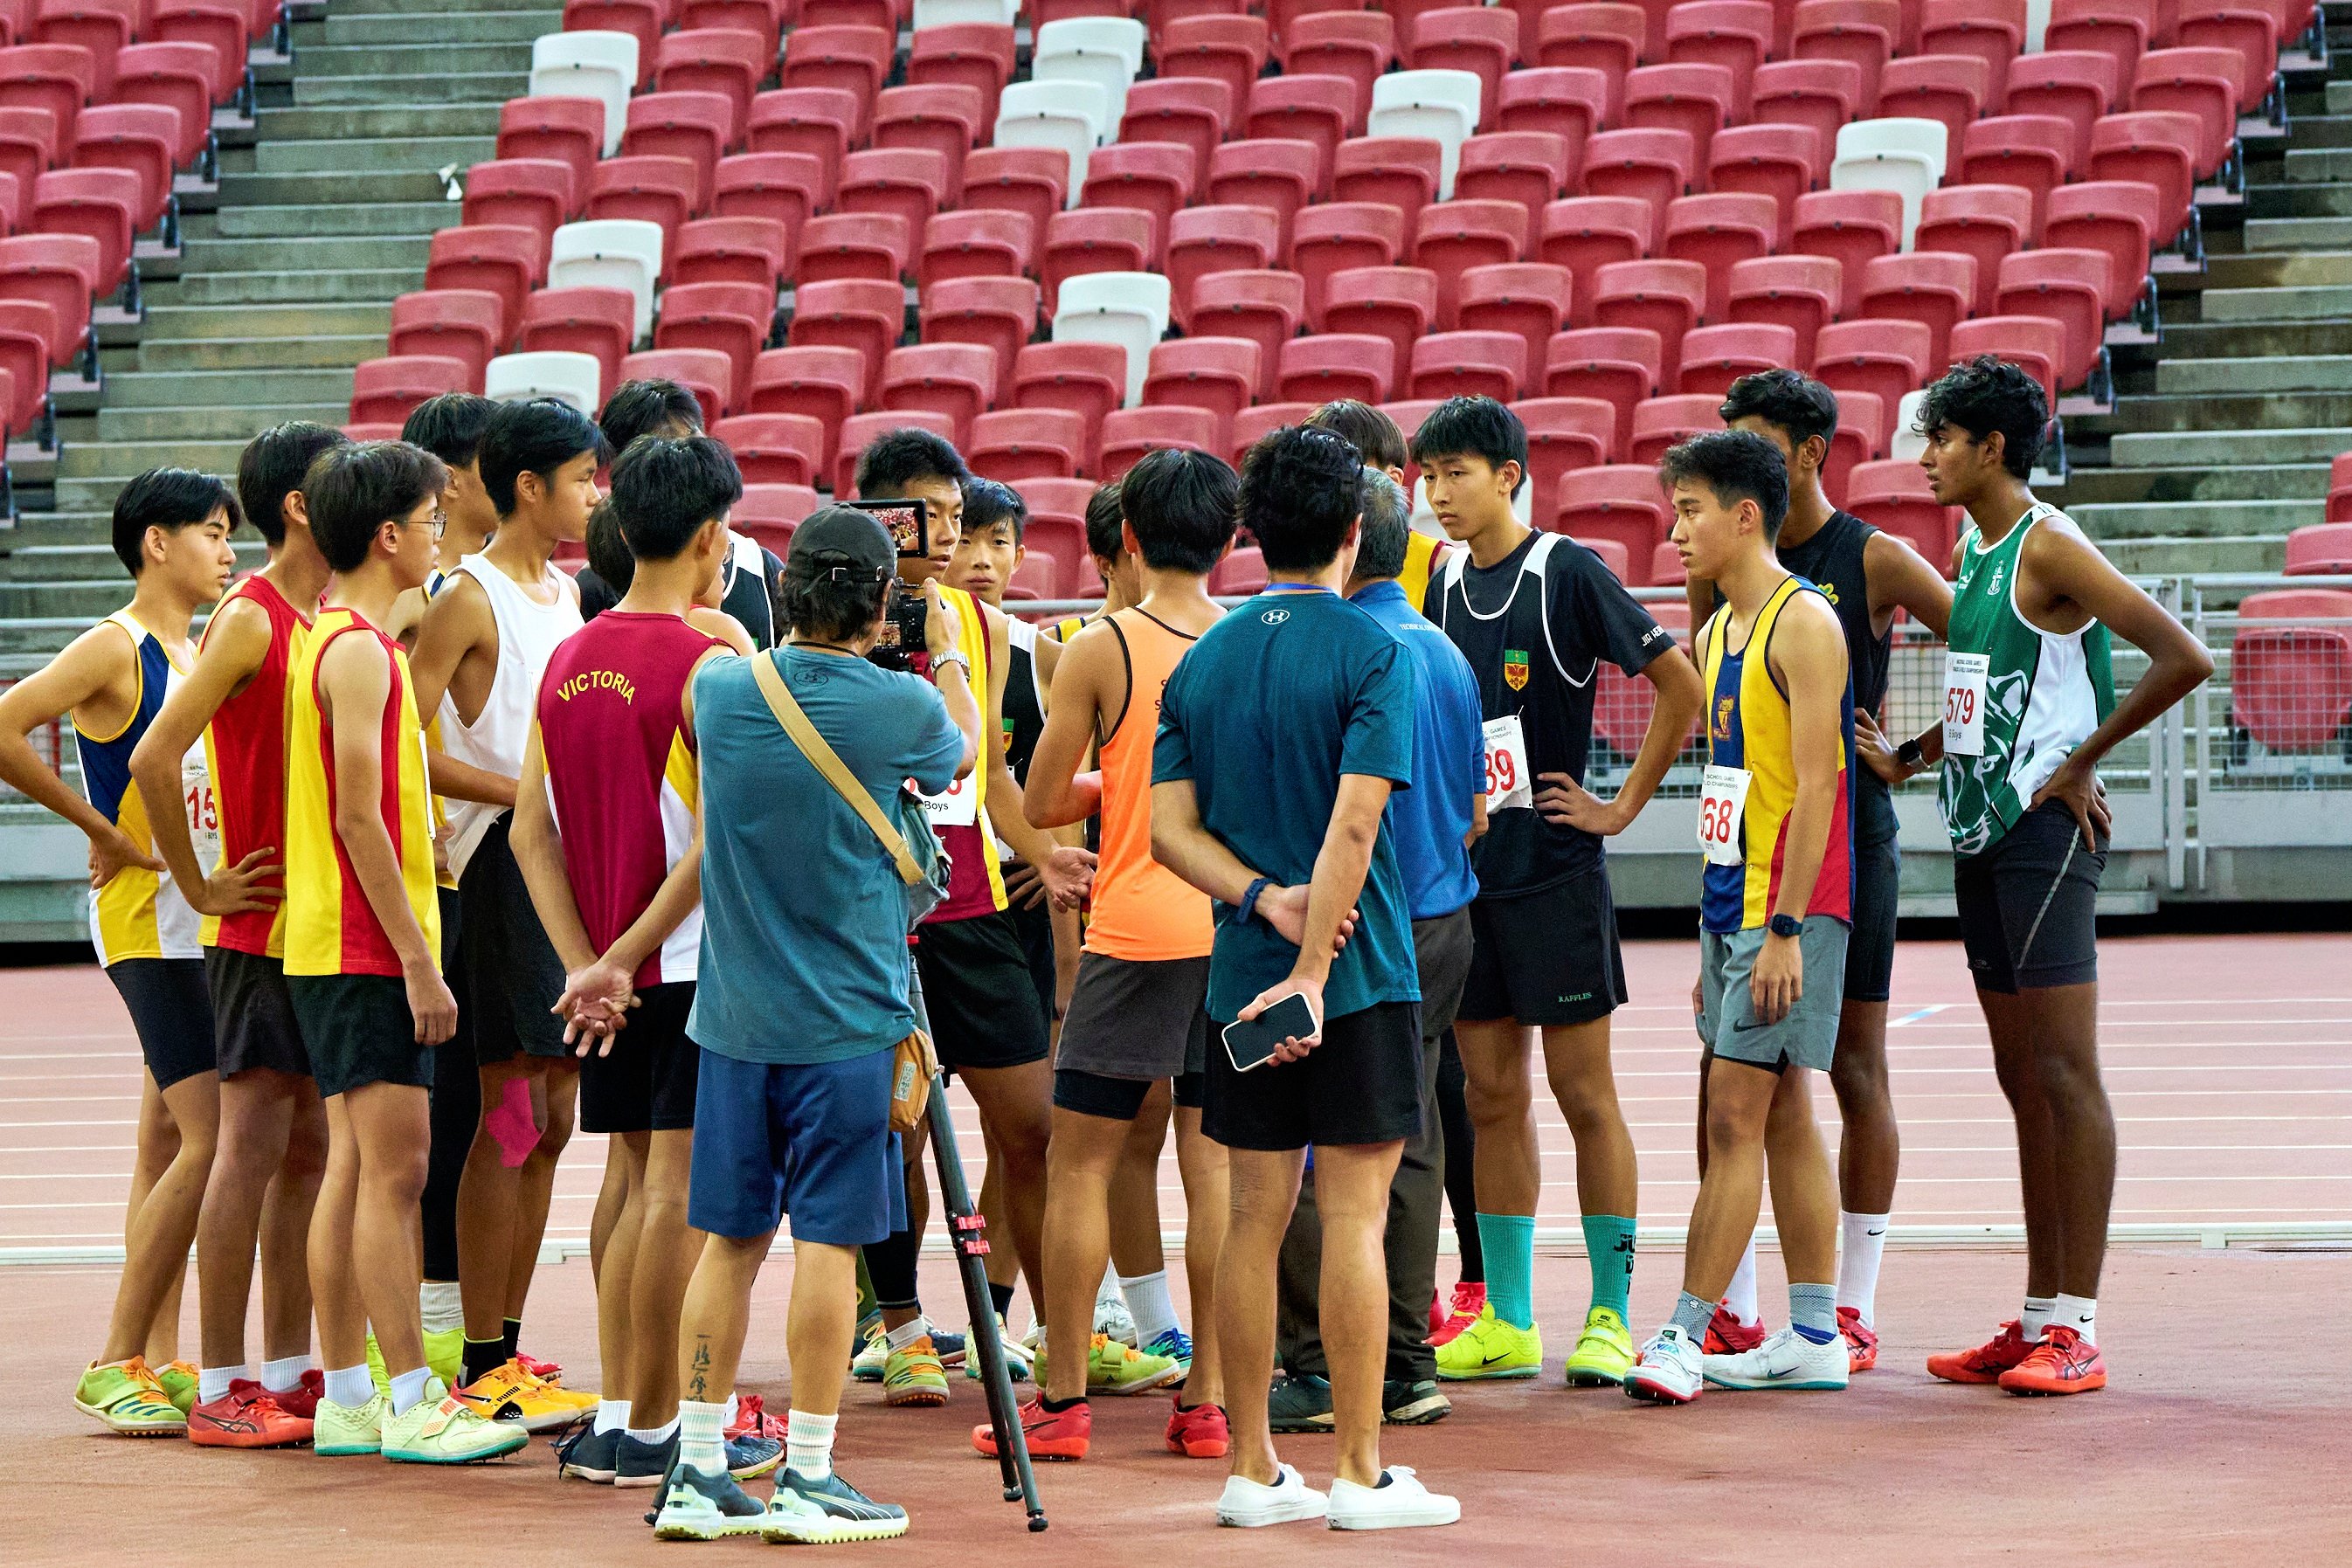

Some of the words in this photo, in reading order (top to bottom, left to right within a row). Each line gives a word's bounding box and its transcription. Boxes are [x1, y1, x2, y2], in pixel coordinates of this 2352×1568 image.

[1642, 633, 1653, 646] JIA
[557, 670, 635, 706] VICTORIA
[1946, 687, 1975, 724] 579
[924, 801, 949, 812] Boys
[1559, 991, 1592, 1002] RAFFLES
[496, 1385, 521, 1402] PUMA
